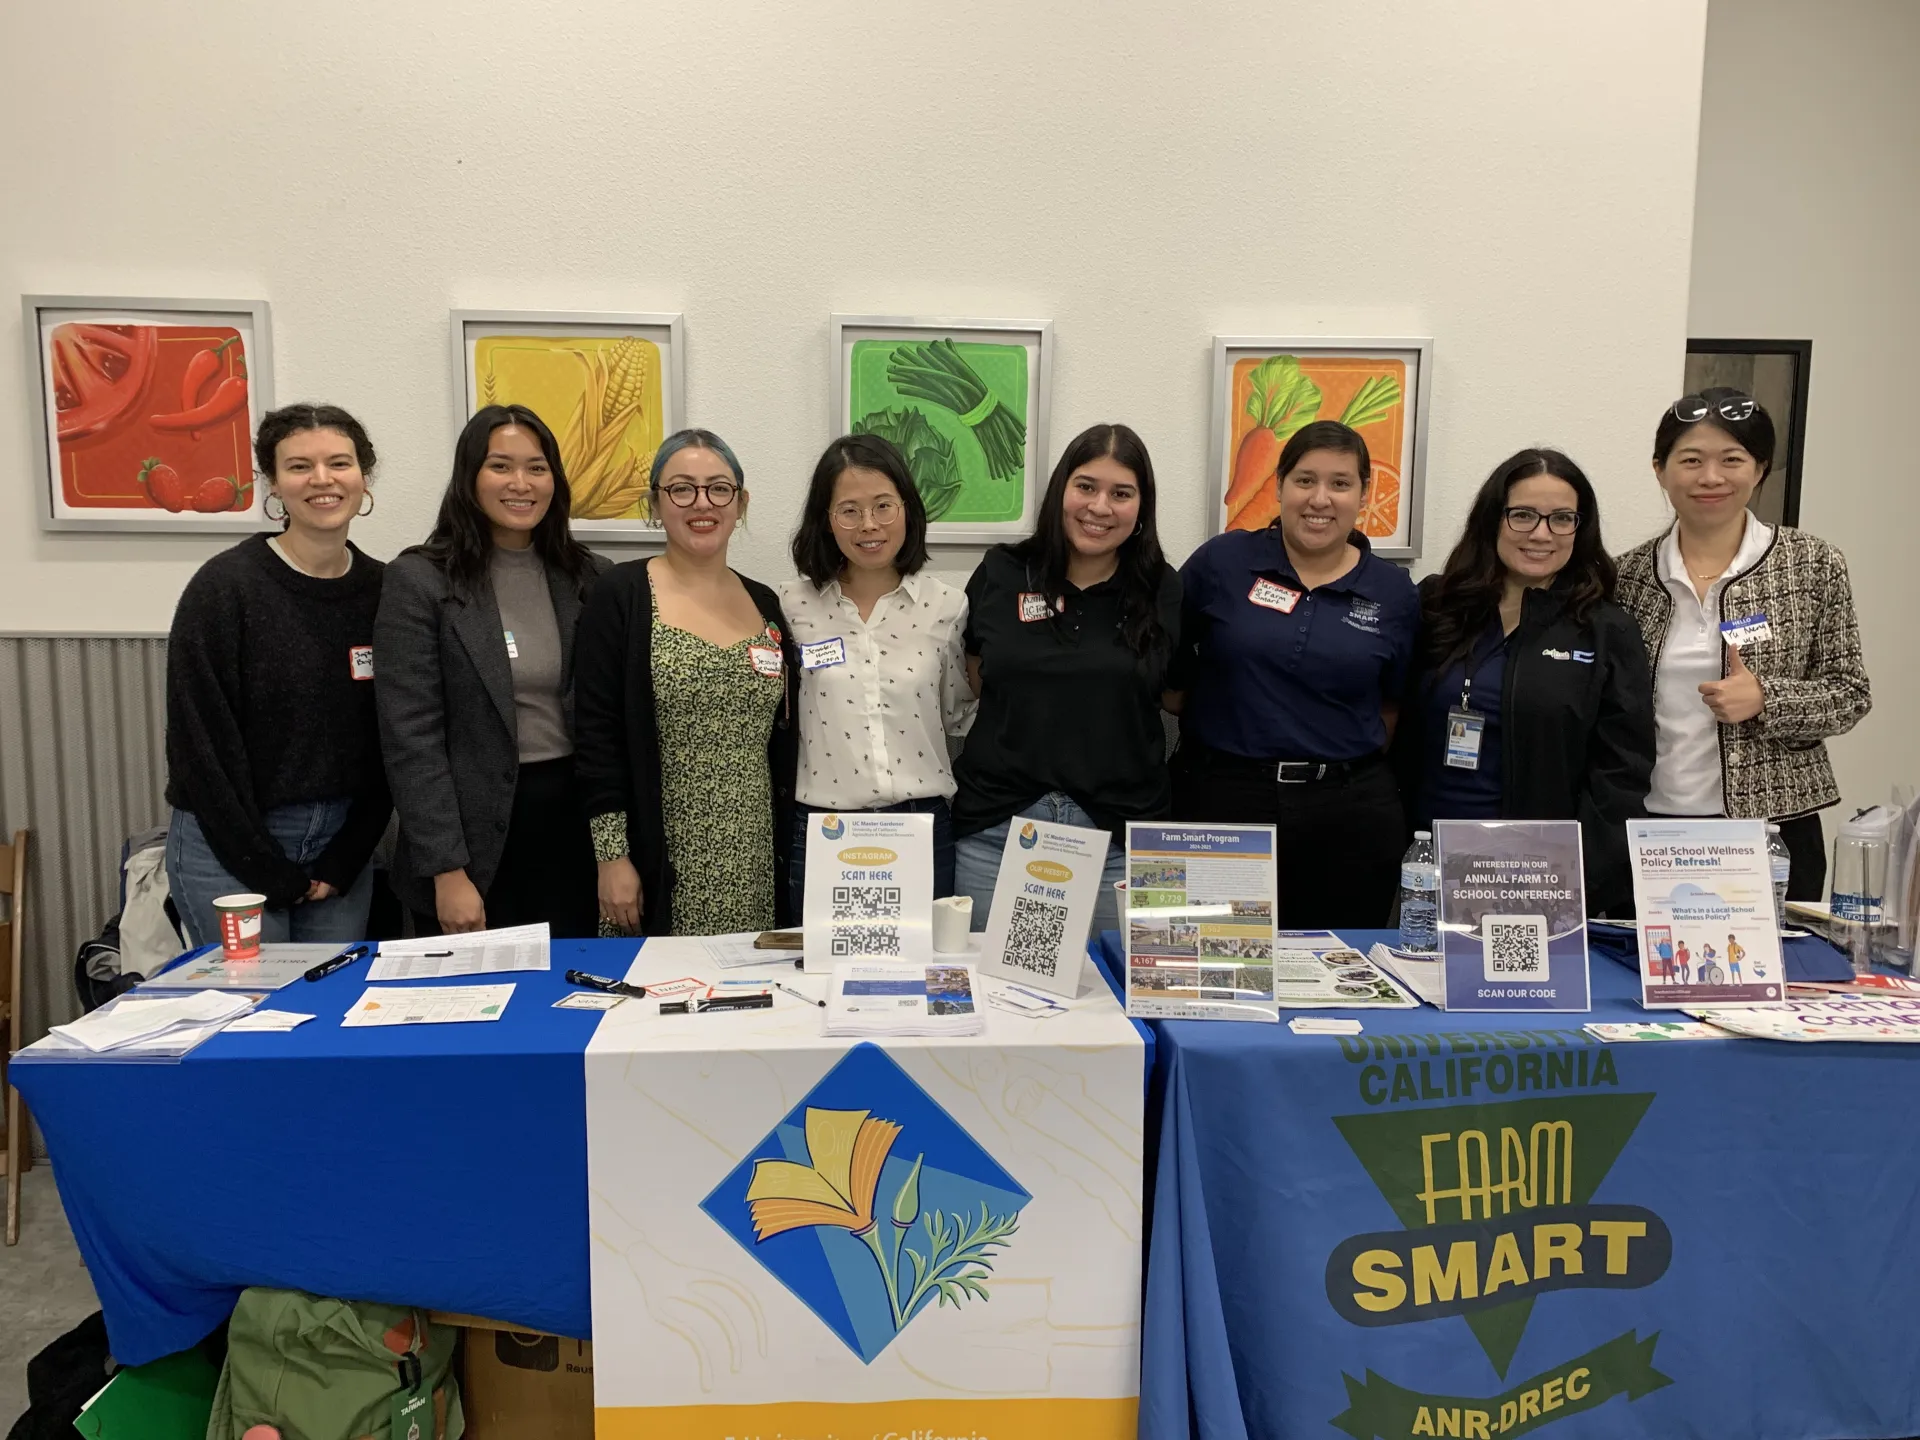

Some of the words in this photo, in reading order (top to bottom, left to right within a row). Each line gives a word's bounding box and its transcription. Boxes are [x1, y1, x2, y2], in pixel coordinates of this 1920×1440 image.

[1254, 592, 1280, 604] Smart
[1264, 590, 1286, 602] Farm
[1349, 611, 1379, 623] SMART
[1731, 617, 1752, 626] HELLO
[1065, 837, 1086, 845] Gardener
[1161, 832, 1181, 842] Farm
[1182, 833, 1205, 842] Smart
[1207, 834, 1240, 845] Program
[842, 852, 893, 861] INSTAGRAM
[1639, 847, 1668, 856] Local
[1670, 846, 1705, 856] School
[1707, 846, 1755, 855] Wellness
[1473, 861, 1521, 869] INTERESTED
[1641, 857, 1673, 868] Policy
[1675, 857, 1721, 867] Refresh!
[841, 870, 866, 881] SCAN
[869, 870, 893, 881] HERE
[1029, 864, 1043, 873] OUR
[1043, 867, 1070, 879] WEBSITE
[1464, 874, 1509, 884] ANNUAL
[1511, 874, 1541, 883] FARM
[1544, 874, 1559, 883] TO
[1023, 882, 1045, 897] SCAN
[1045, 886, 1067, 901] HERE
[1453, 890, 1498, 899] SCHOOL
[1500, 890, 1572, 900] CONFERENCE
[1134, 957, 1154, 965] 4,167
[1477, 989, 1505, 998] SCAN
[1507, 989, 1527, 998] OUR
[1529, 989, 1556, 998] CODE
[1335, 1029, 1595, 1063] UNIVERSITY
[1359, 1047, 1619, 1106] CALIFORNIA
[1416, 1120, 1574, 1225] FARM
[1352, 1220, 1647, 1312] SMART
[401, 1396, 426, 1416] TAIWAN
[1411, 1367, 1591, 1440] ANR-DREC
